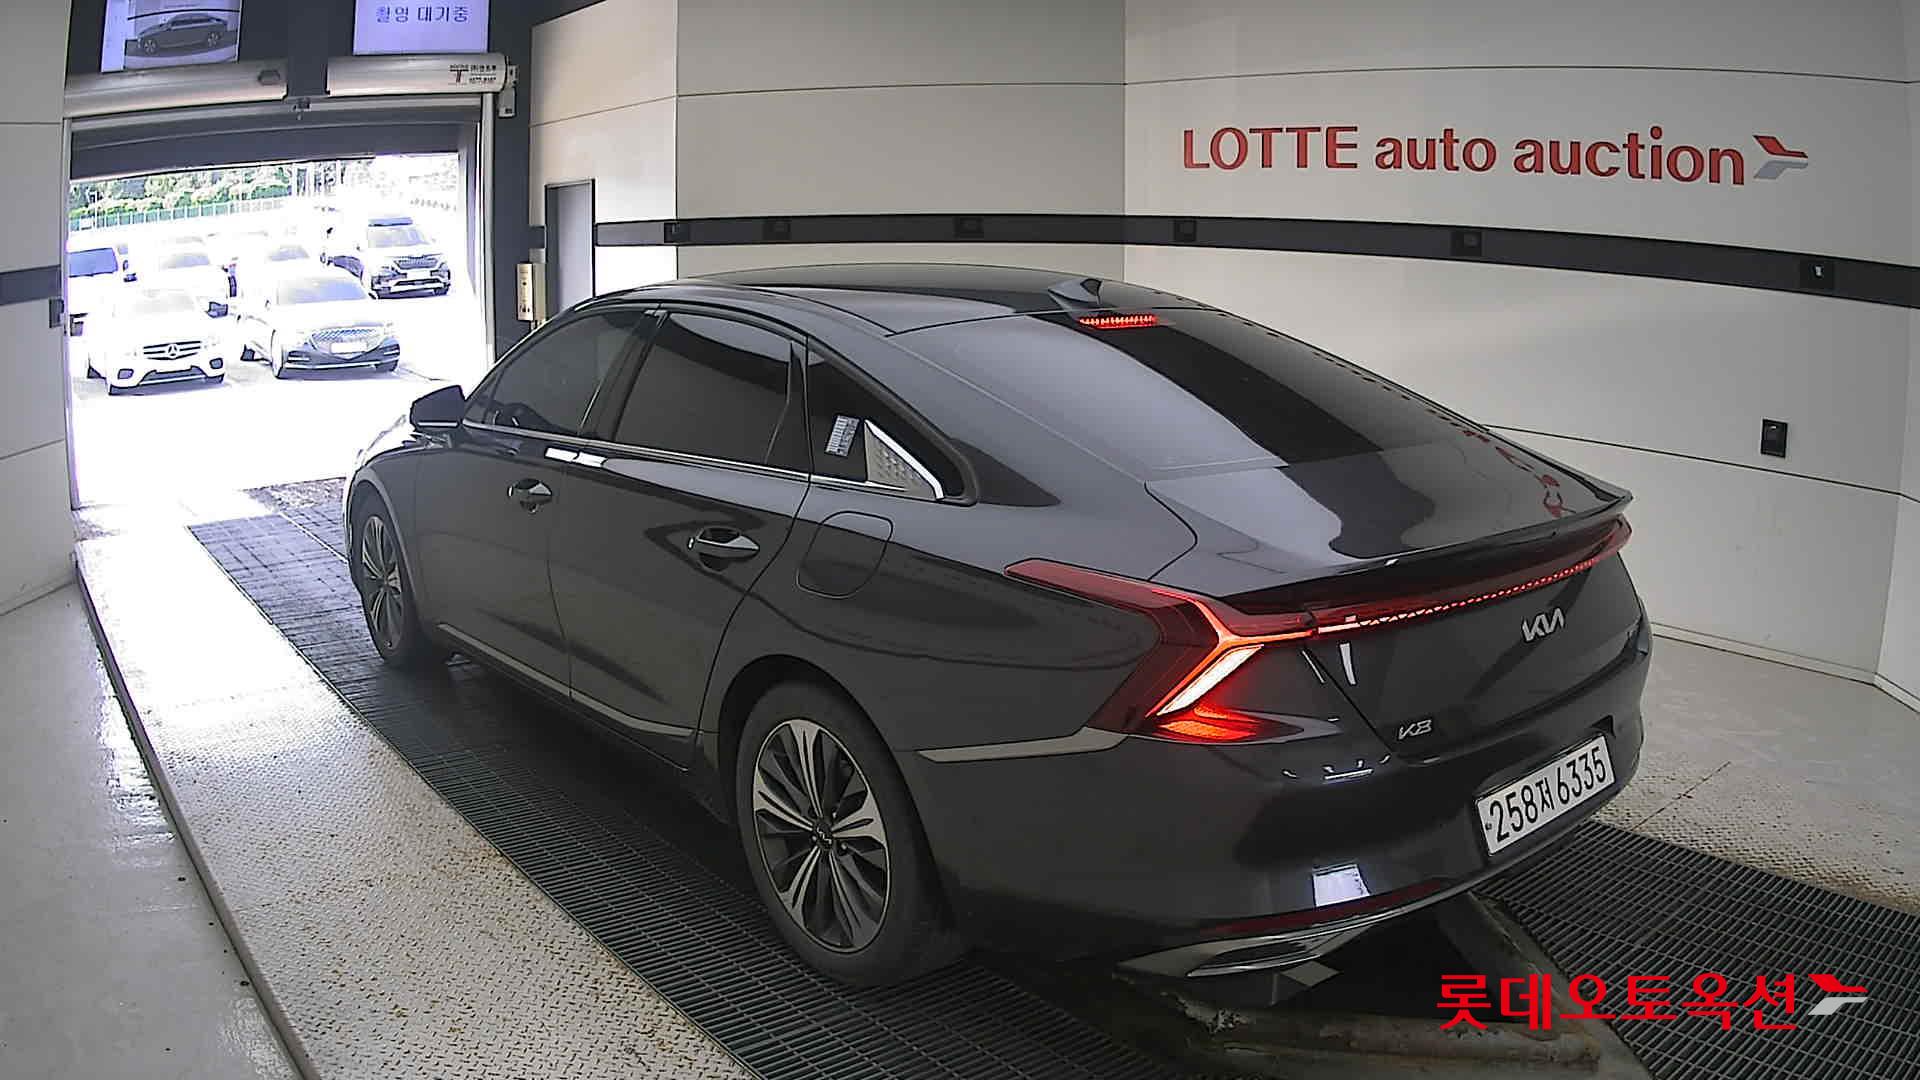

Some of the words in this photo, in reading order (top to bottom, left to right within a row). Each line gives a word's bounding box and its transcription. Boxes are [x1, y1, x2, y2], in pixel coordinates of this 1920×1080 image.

[417, 5, 468, 23] 대기중
[1183, 126, 1358, 171] LOTTE
[1375, 128, 1498, 172] auto
[1513, 126, 1746, 186] auction
[1522, 608, 1565, 641] KIA
[1398, 719, 1433, 740] K8
